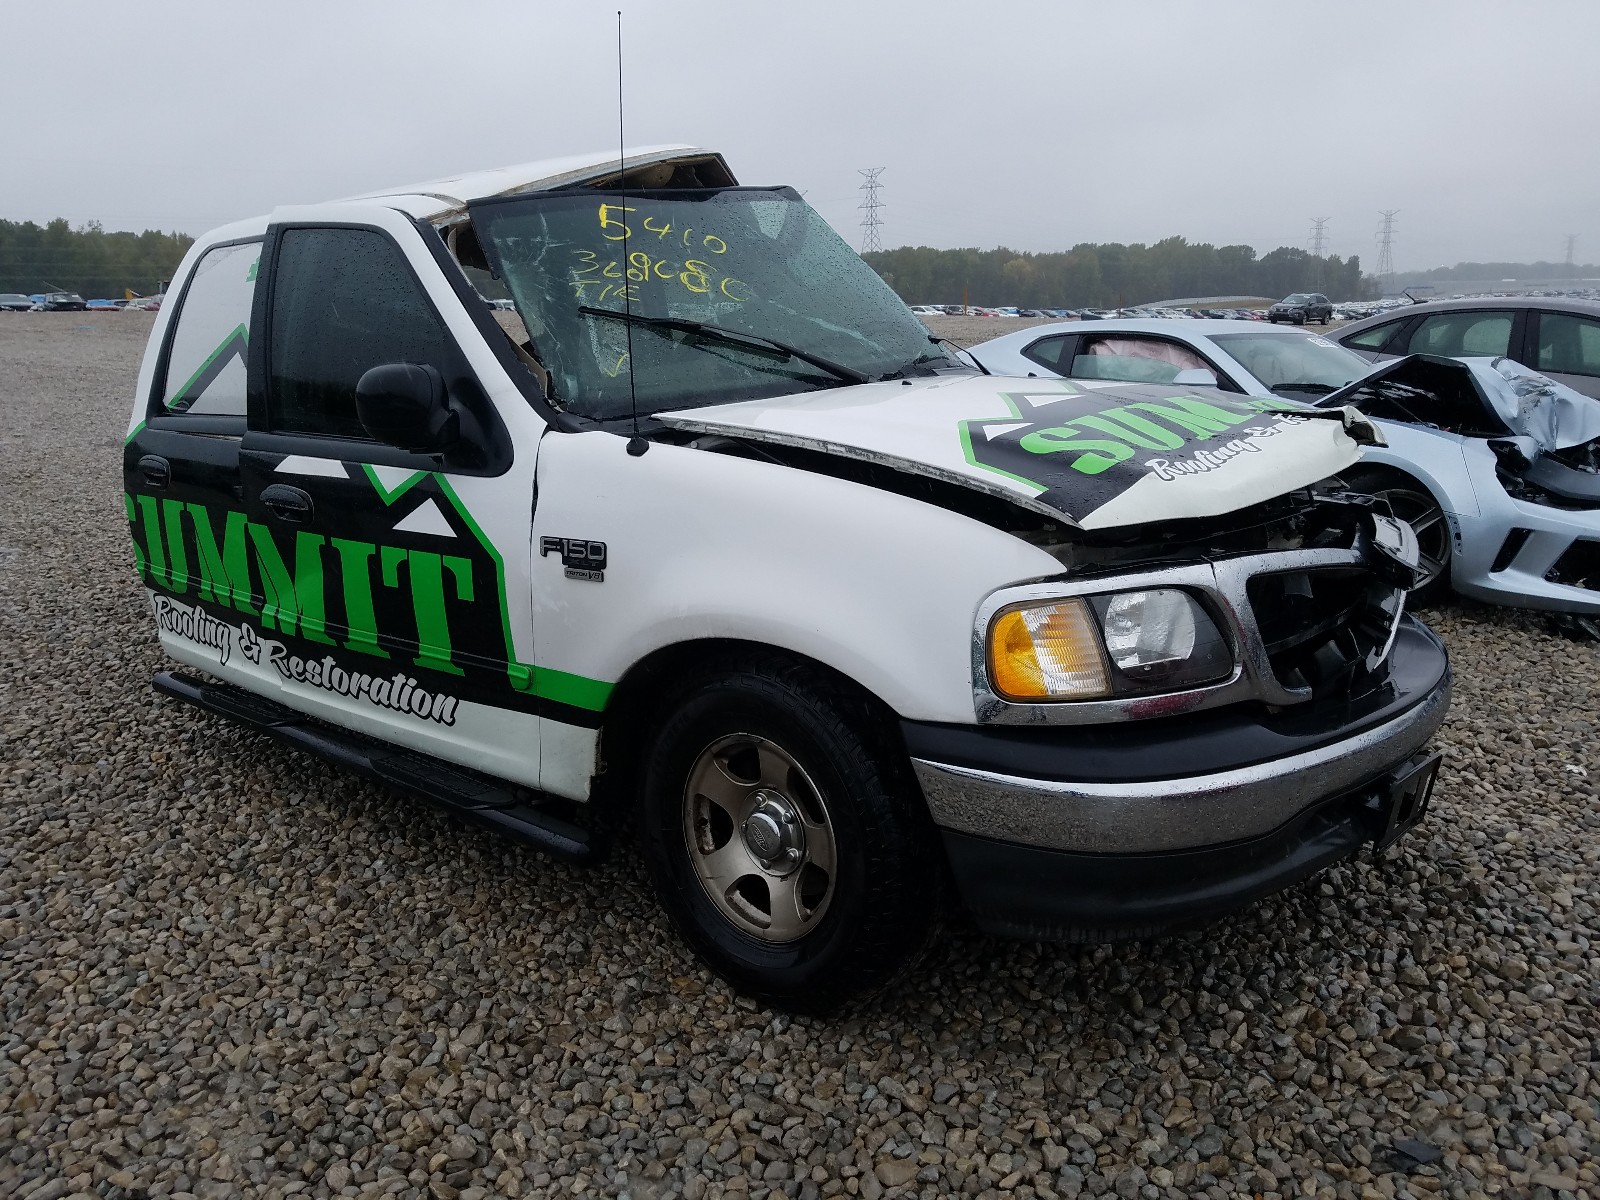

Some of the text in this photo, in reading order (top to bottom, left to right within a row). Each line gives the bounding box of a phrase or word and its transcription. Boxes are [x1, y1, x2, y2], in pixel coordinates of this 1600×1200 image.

[1145, 437, 1262, 482] Roofing
[153, 592, 459, 726] Roofing & Restoration
